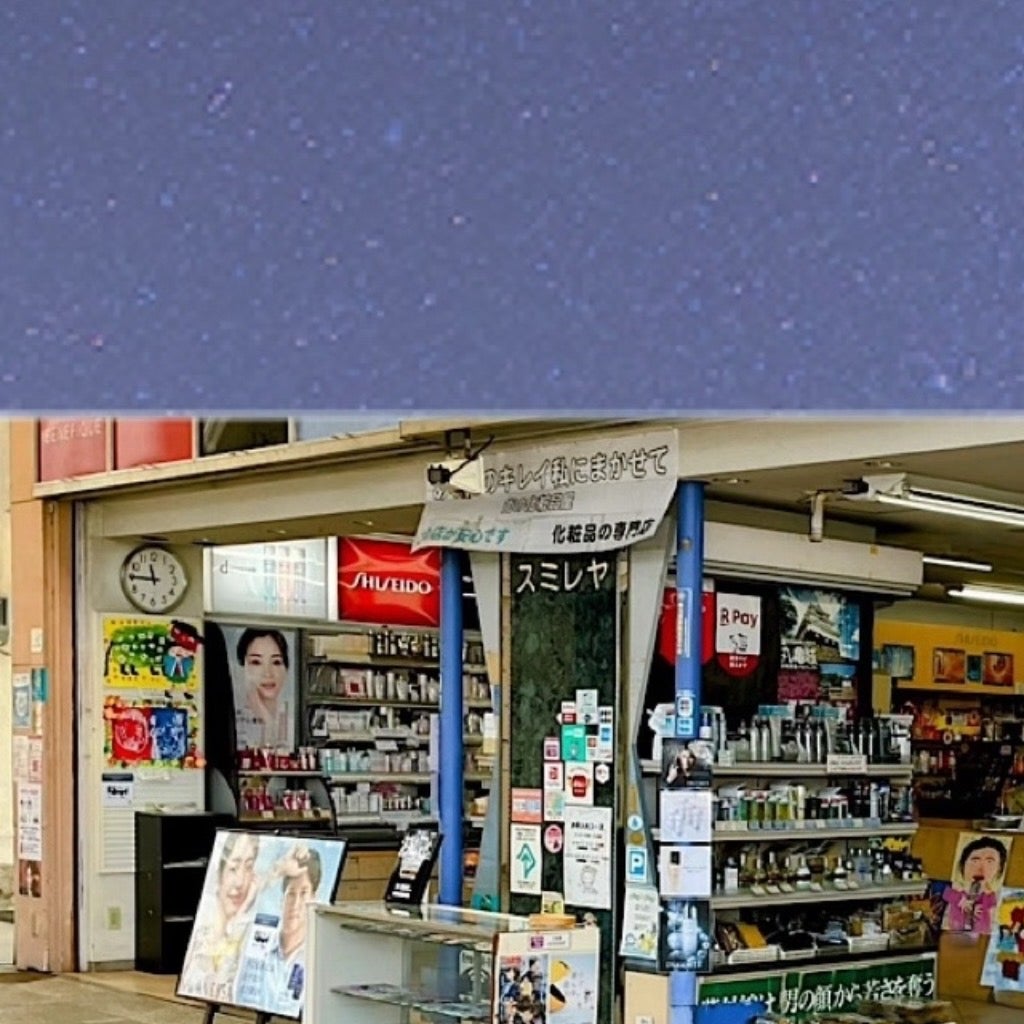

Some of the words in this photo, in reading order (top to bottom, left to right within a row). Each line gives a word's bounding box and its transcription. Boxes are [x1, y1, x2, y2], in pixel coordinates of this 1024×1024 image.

[430, 444, 668, 499] のキレイ私にまかせて
[350, 572, 432, 595] SHISEIDO
[516, 559, 608, 594] スミレヤ
[732, 609, 758, 628] Pay
[701, 972, 935, 1014] は男の顔から若さを奪う
